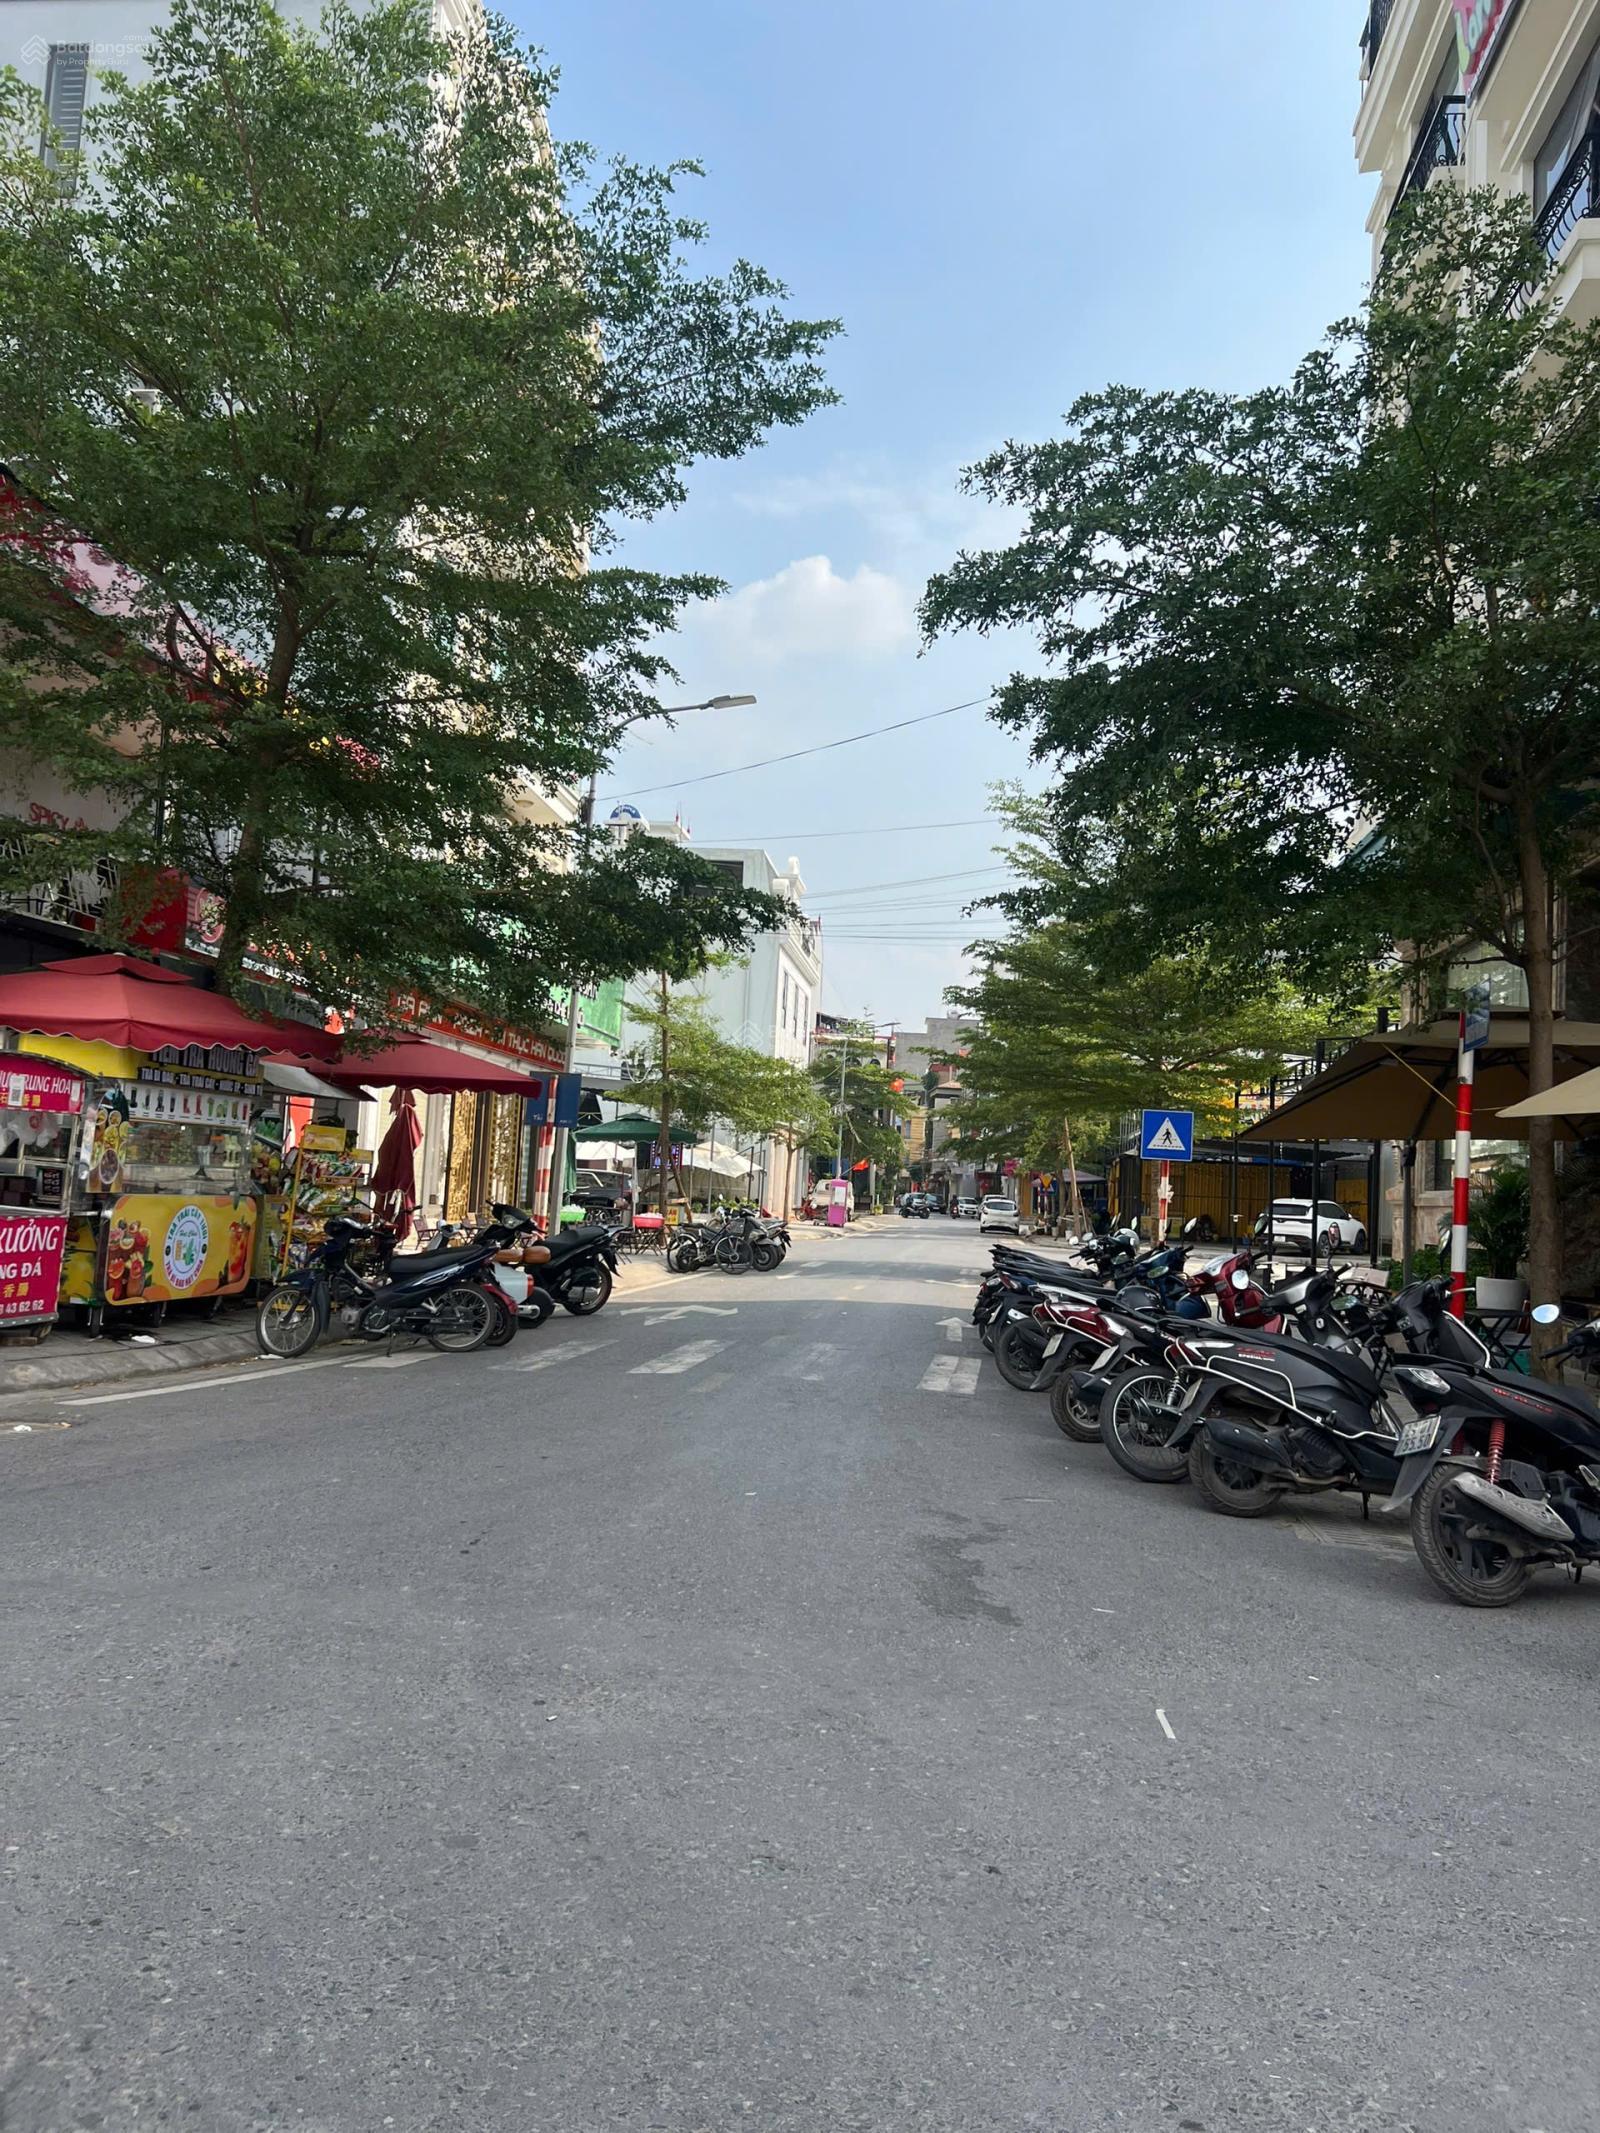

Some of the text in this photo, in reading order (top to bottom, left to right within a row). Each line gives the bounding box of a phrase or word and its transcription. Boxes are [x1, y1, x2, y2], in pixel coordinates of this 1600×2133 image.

[30, 802, 69, 830] SPICY
[51, 1076, 71, 1094] HOA
[21, 1256, 42, 1277] ĐÁ
